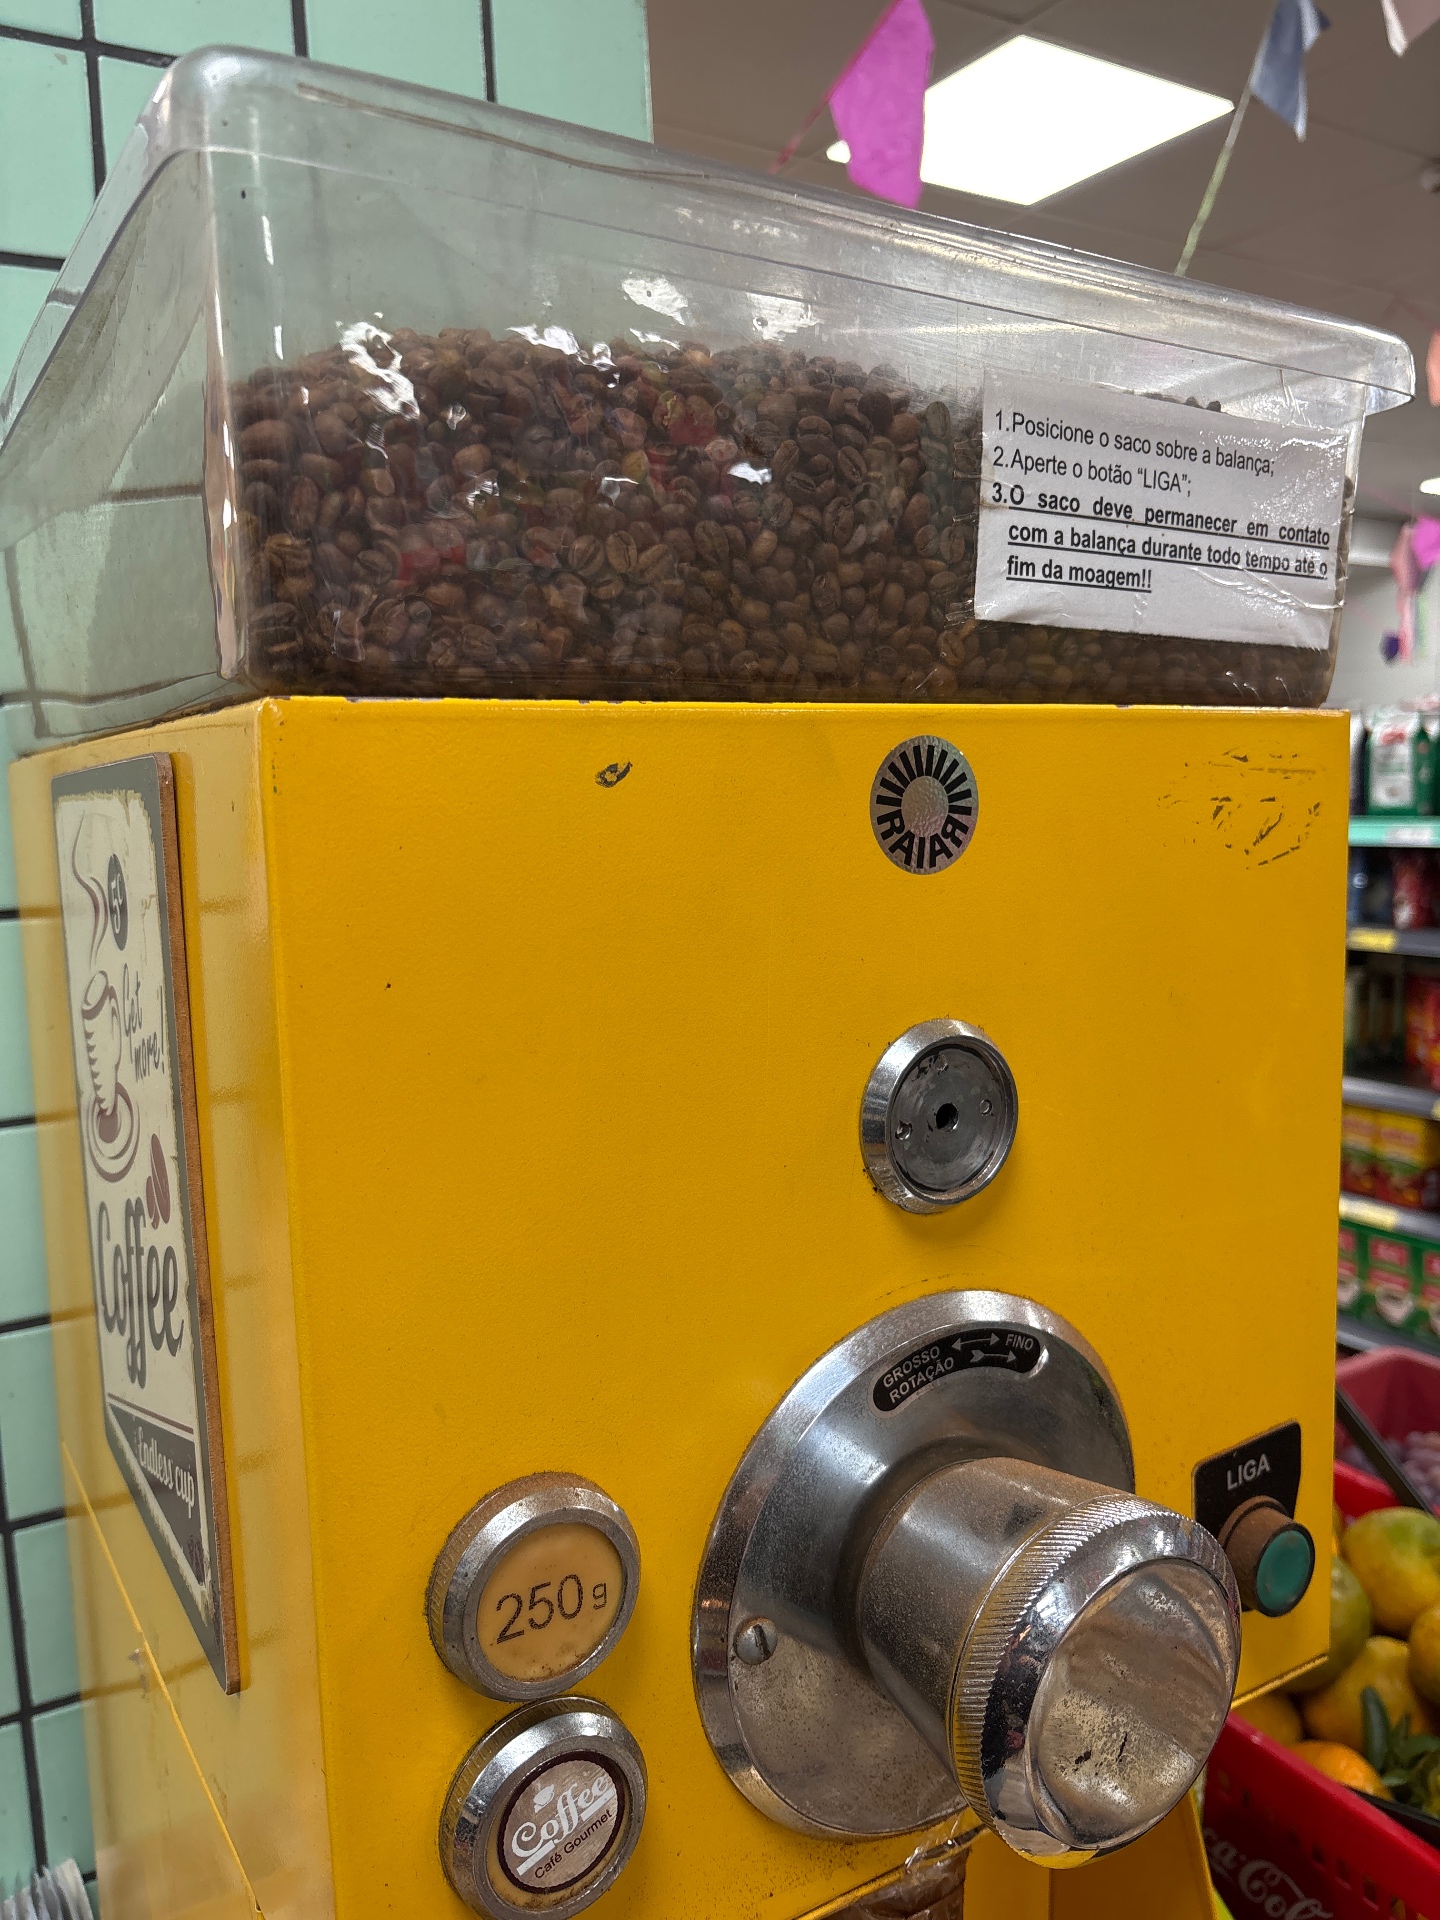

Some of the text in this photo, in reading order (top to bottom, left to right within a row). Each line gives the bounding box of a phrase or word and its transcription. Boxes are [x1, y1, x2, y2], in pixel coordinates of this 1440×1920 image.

[1072, 463, 1083, 479] o
[1088, 460, 1132, 486] botão
[1100, 433, 1109, 447] o
[1114, 434, 1151, 455] saco
[1156, 440, 1197, 463] sobre
[1202, 449, 1211, 464] a
[1216, 448, 1275, 479] balança;
[1038, 494, 1080, 513] saco
[1092, 499, 1133, 520] deve
[1144, 505, 1237, 535] permanecer
[1247, 519, 1269, 538] em
[1279, 524, 1330, 547] contato
[1007, 556, 1152, 590] fim da moagem!!
[1008, 523, 1328, 576] com a balança durante todo tempo até o
[122, 962, 142, 1063] Get
[134, 985, 165, 1083] more!
[99, 1196, 184, 1389] Coffee
[883, 1346, 940, 1388] GROSSO
[1005, 1333, 1034, 1351] FINO
[889, 1356, 954, 1403] ROTAÇÃO
[138, 1426, 195, 1518] Endless cup
[1226, 1453, 1270, 1491] LIGA
[511, 1776, 609, 1858] Coffee
[534, 1809, 613, 1879] Café Gourmet
